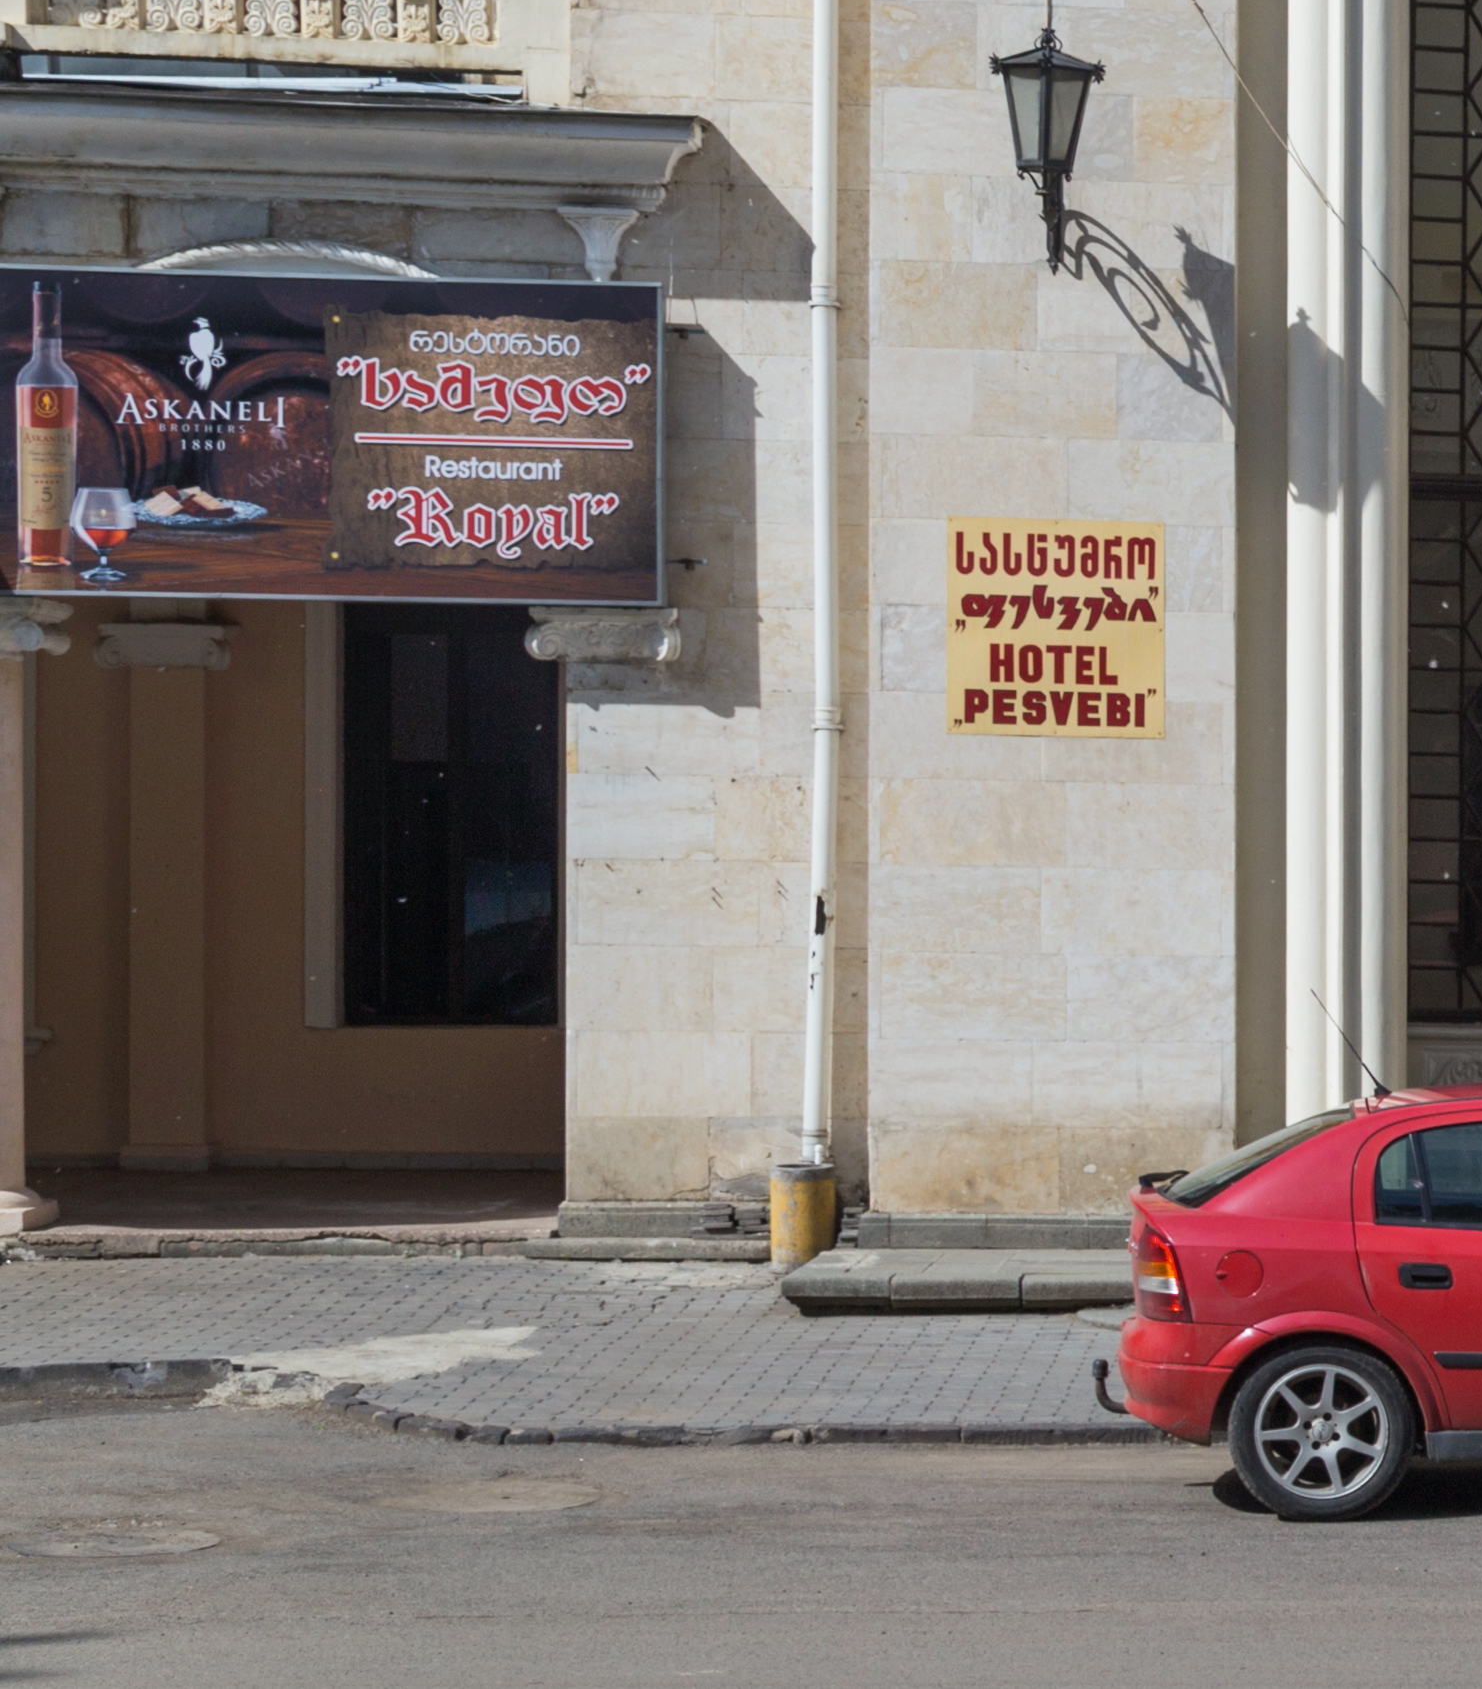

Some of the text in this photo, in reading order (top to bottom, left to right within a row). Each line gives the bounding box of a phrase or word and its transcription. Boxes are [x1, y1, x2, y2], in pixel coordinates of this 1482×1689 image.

[409, 329, 581, 357] რესტორანი
[116, 392, 285, 428] ASKANELI
[159, 423, 246, 434] BROTHERS
[180, 439, 226, 451] 1880
[424, 455, 563, 480] Restaurant
[41, 486, 53, 503] 5
[955, 531, 1156, 580] სასტუმრო
[989, 643, 1119, 686] HOTEL
